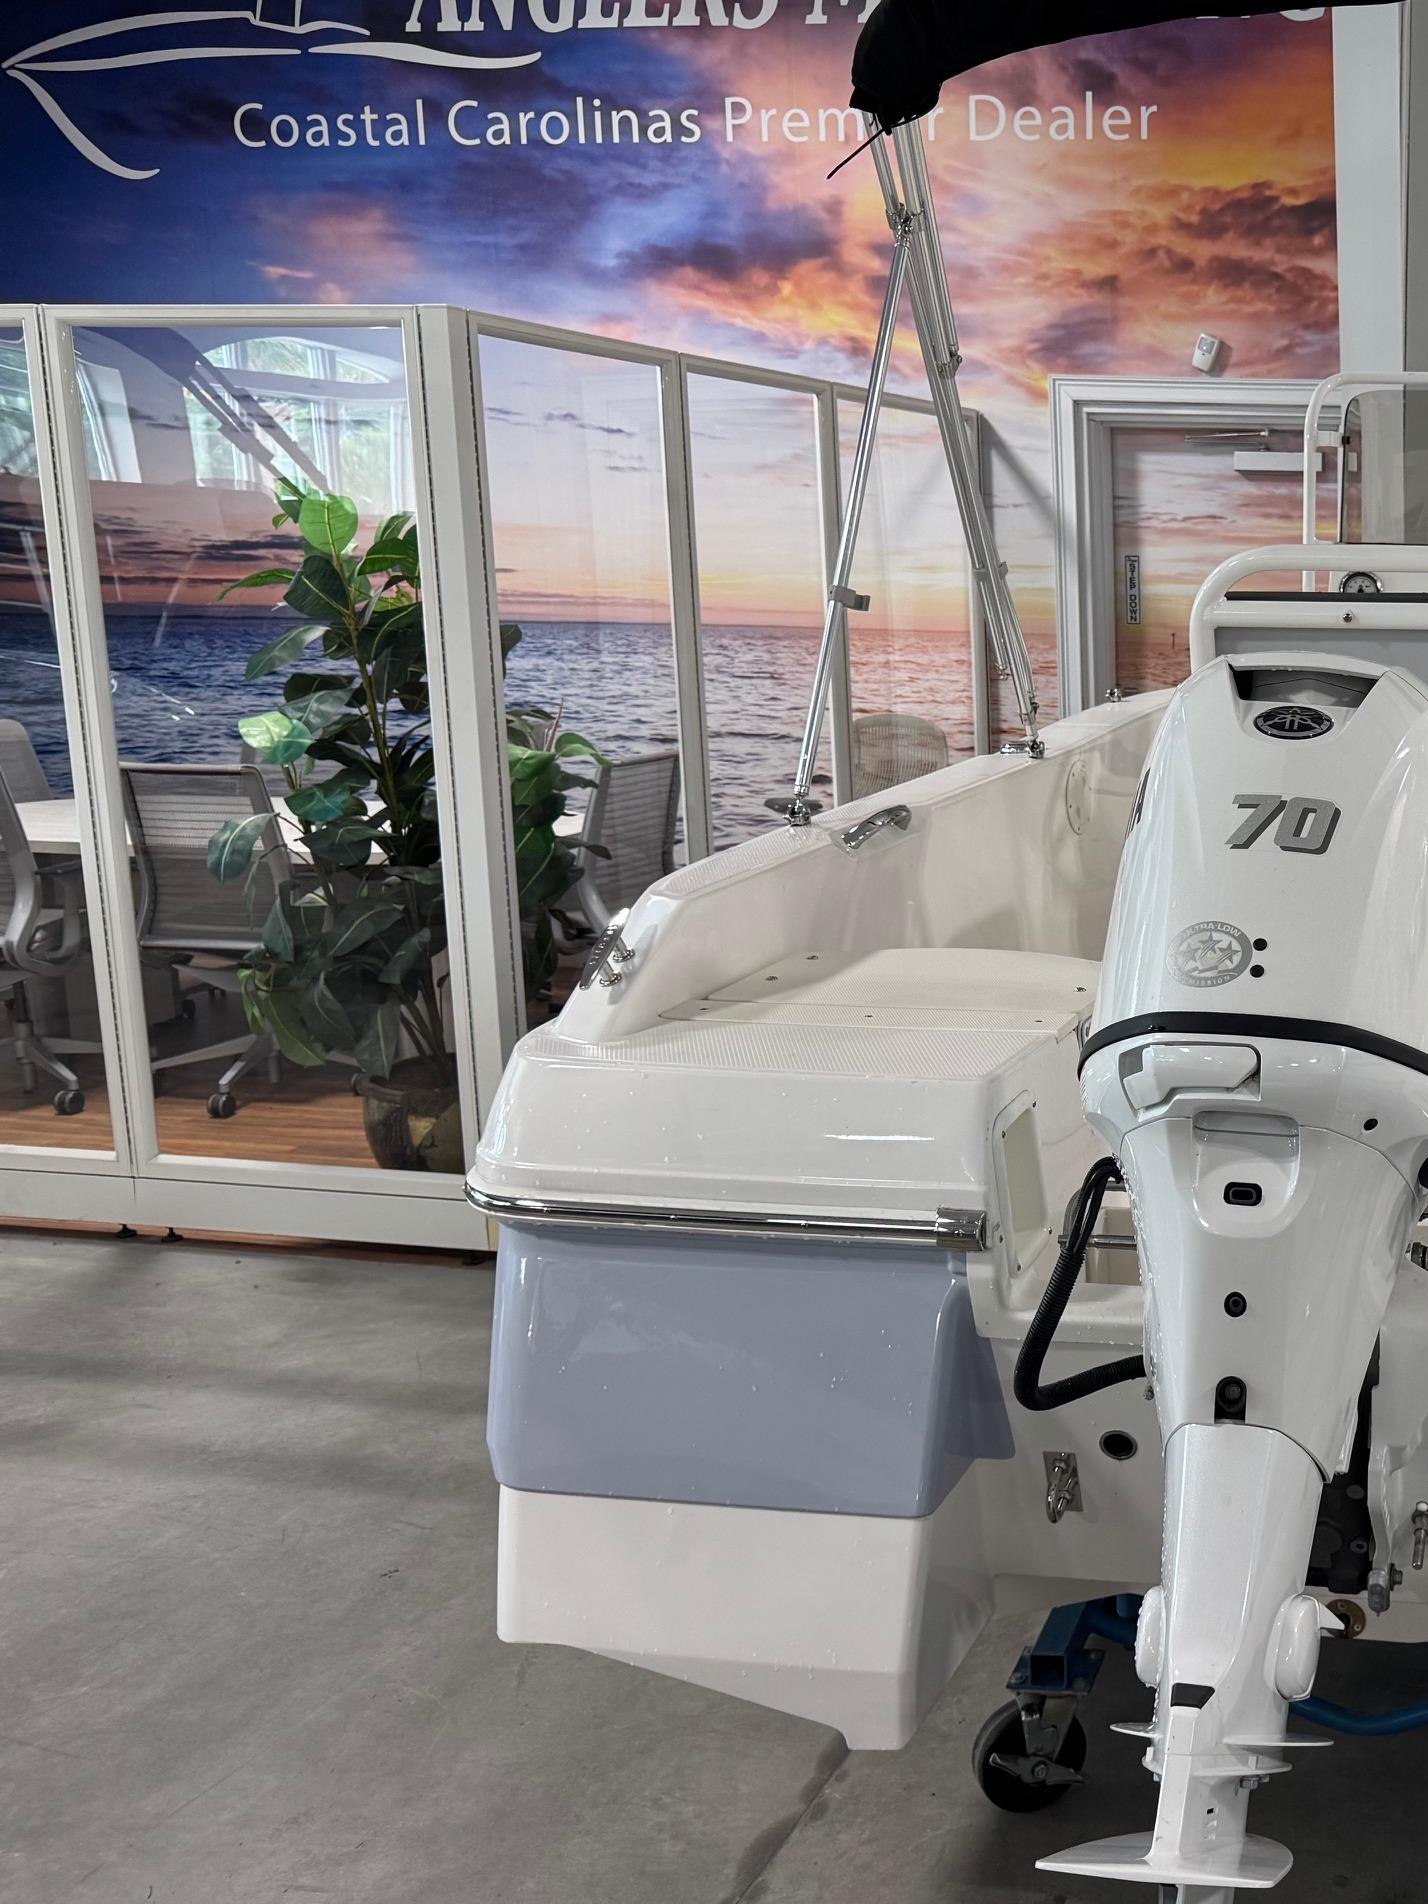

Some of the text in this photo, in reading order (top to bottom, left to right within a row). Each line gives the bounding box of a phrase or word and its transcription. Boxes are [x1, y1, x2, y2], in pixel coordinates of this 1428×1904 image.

[233, 91, 1158, 148] Coastal Carolinas Premr Dealer
[1224, 794, 1342, 855] 70
